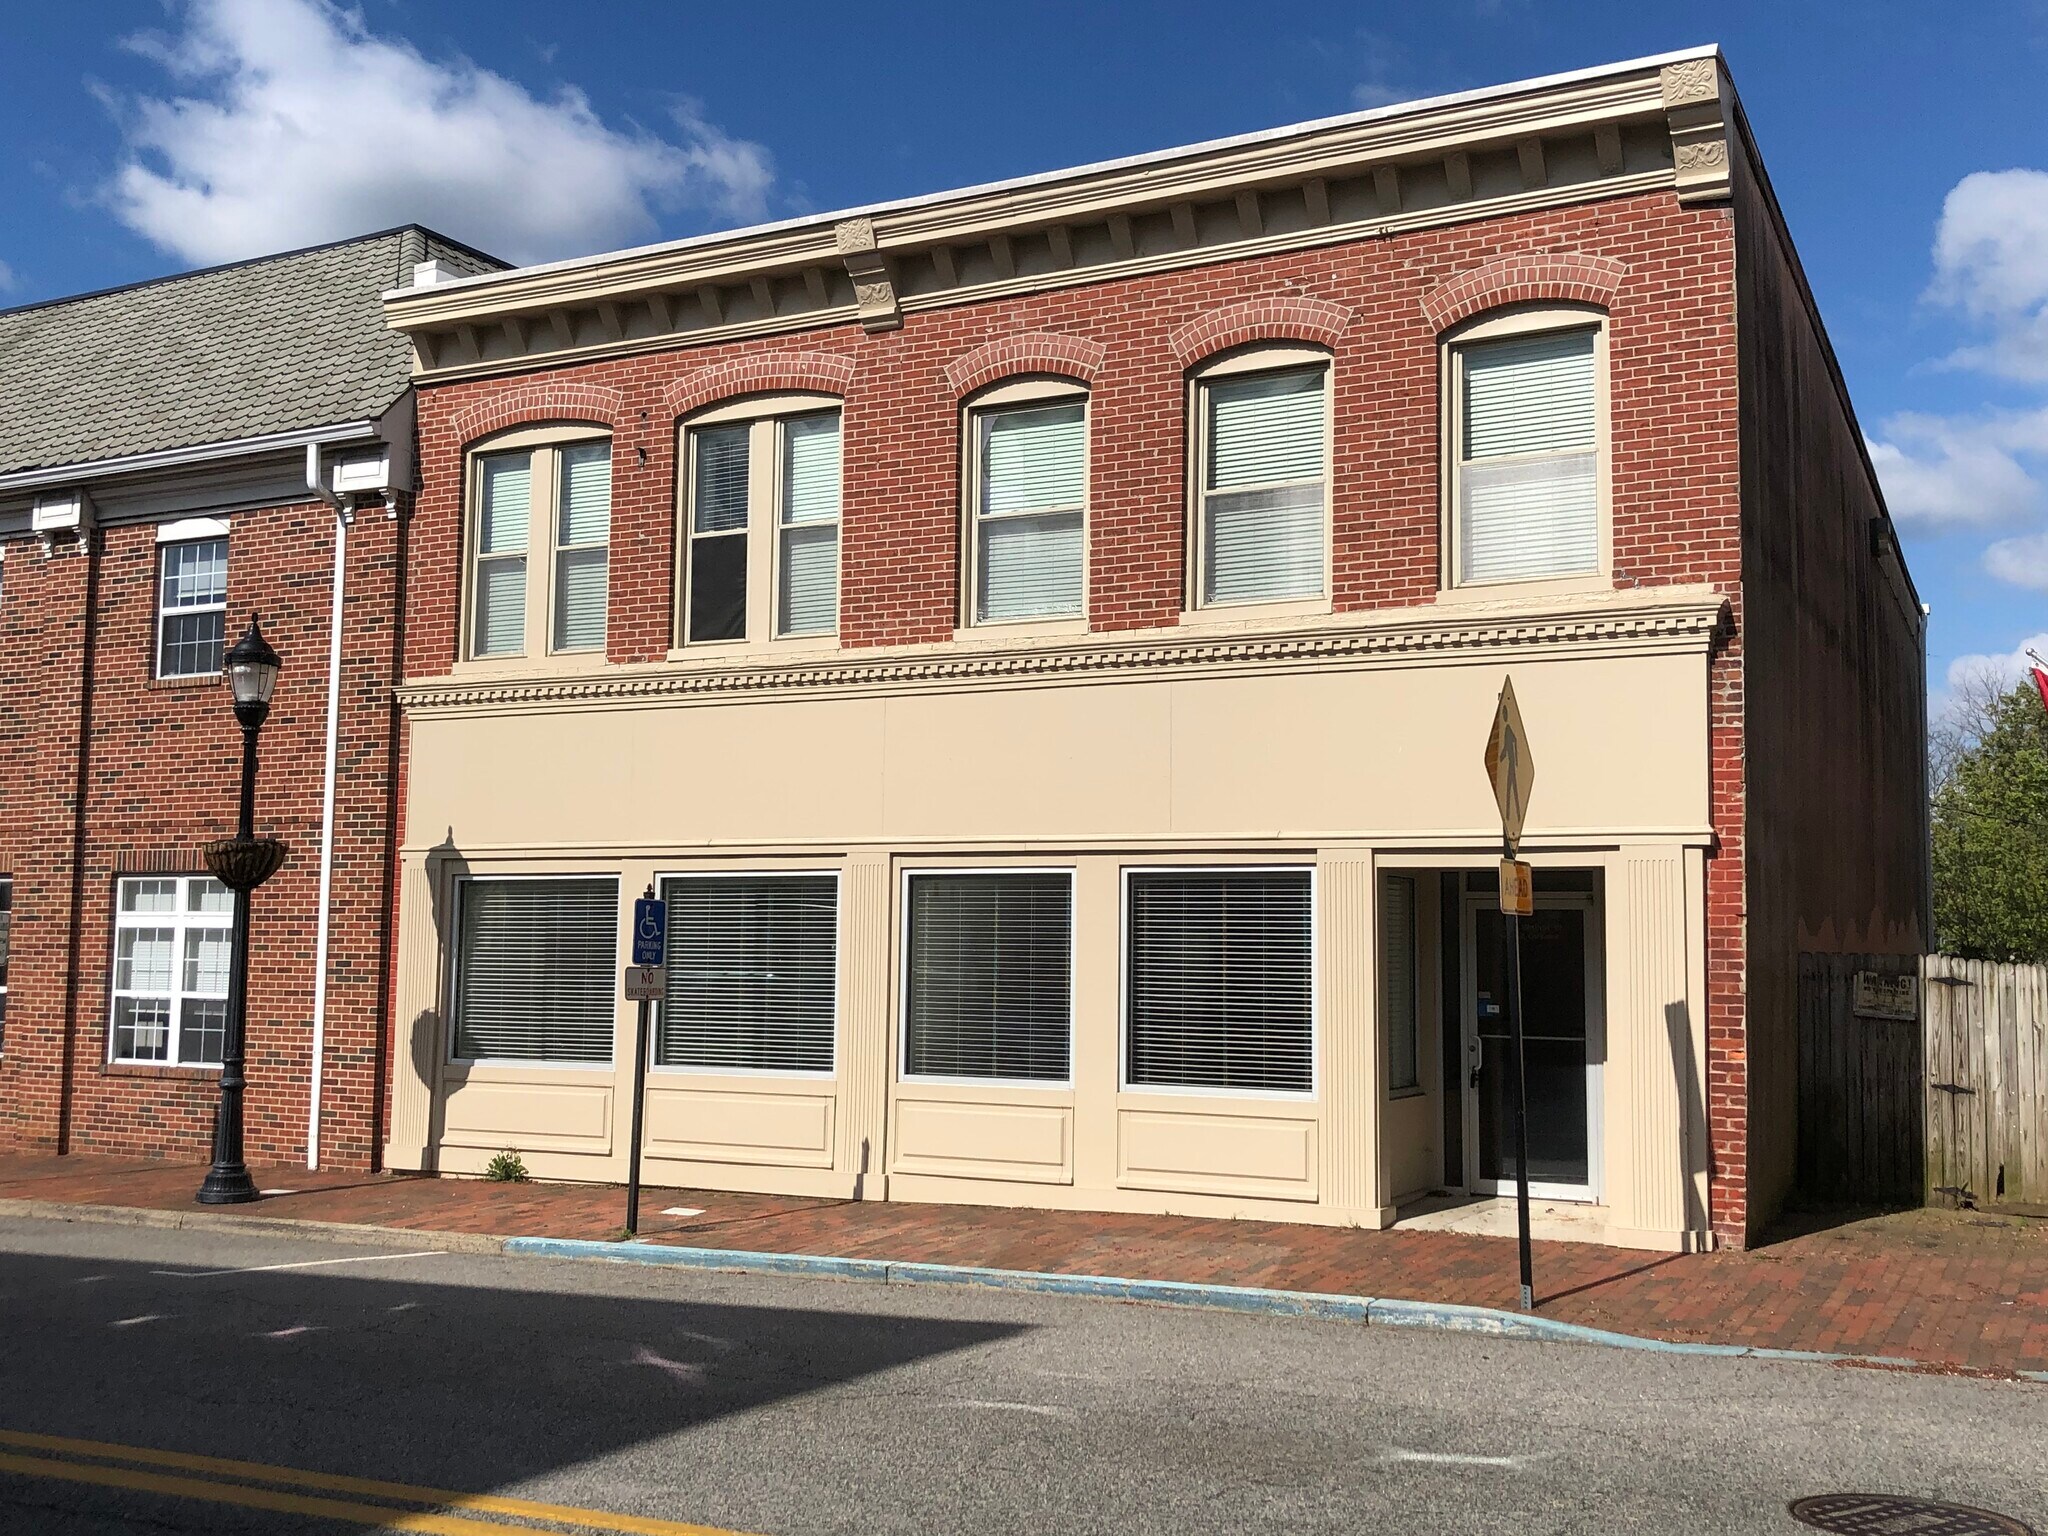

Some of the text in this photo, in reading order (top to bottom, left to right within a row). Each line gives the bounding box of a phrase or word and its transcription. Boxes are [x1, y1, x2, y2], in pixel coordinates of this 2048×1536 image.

[1504, 877, 1528, 898] AHEAD
[637, 940, 662, 950] PARKING
[641, 950, 657, 960] ONLY
[641, 972, 654, 984] NO
[1863, 972, 1911, 990] WANNG!
[627, 987, 664, 996] SKATEBOARDING
